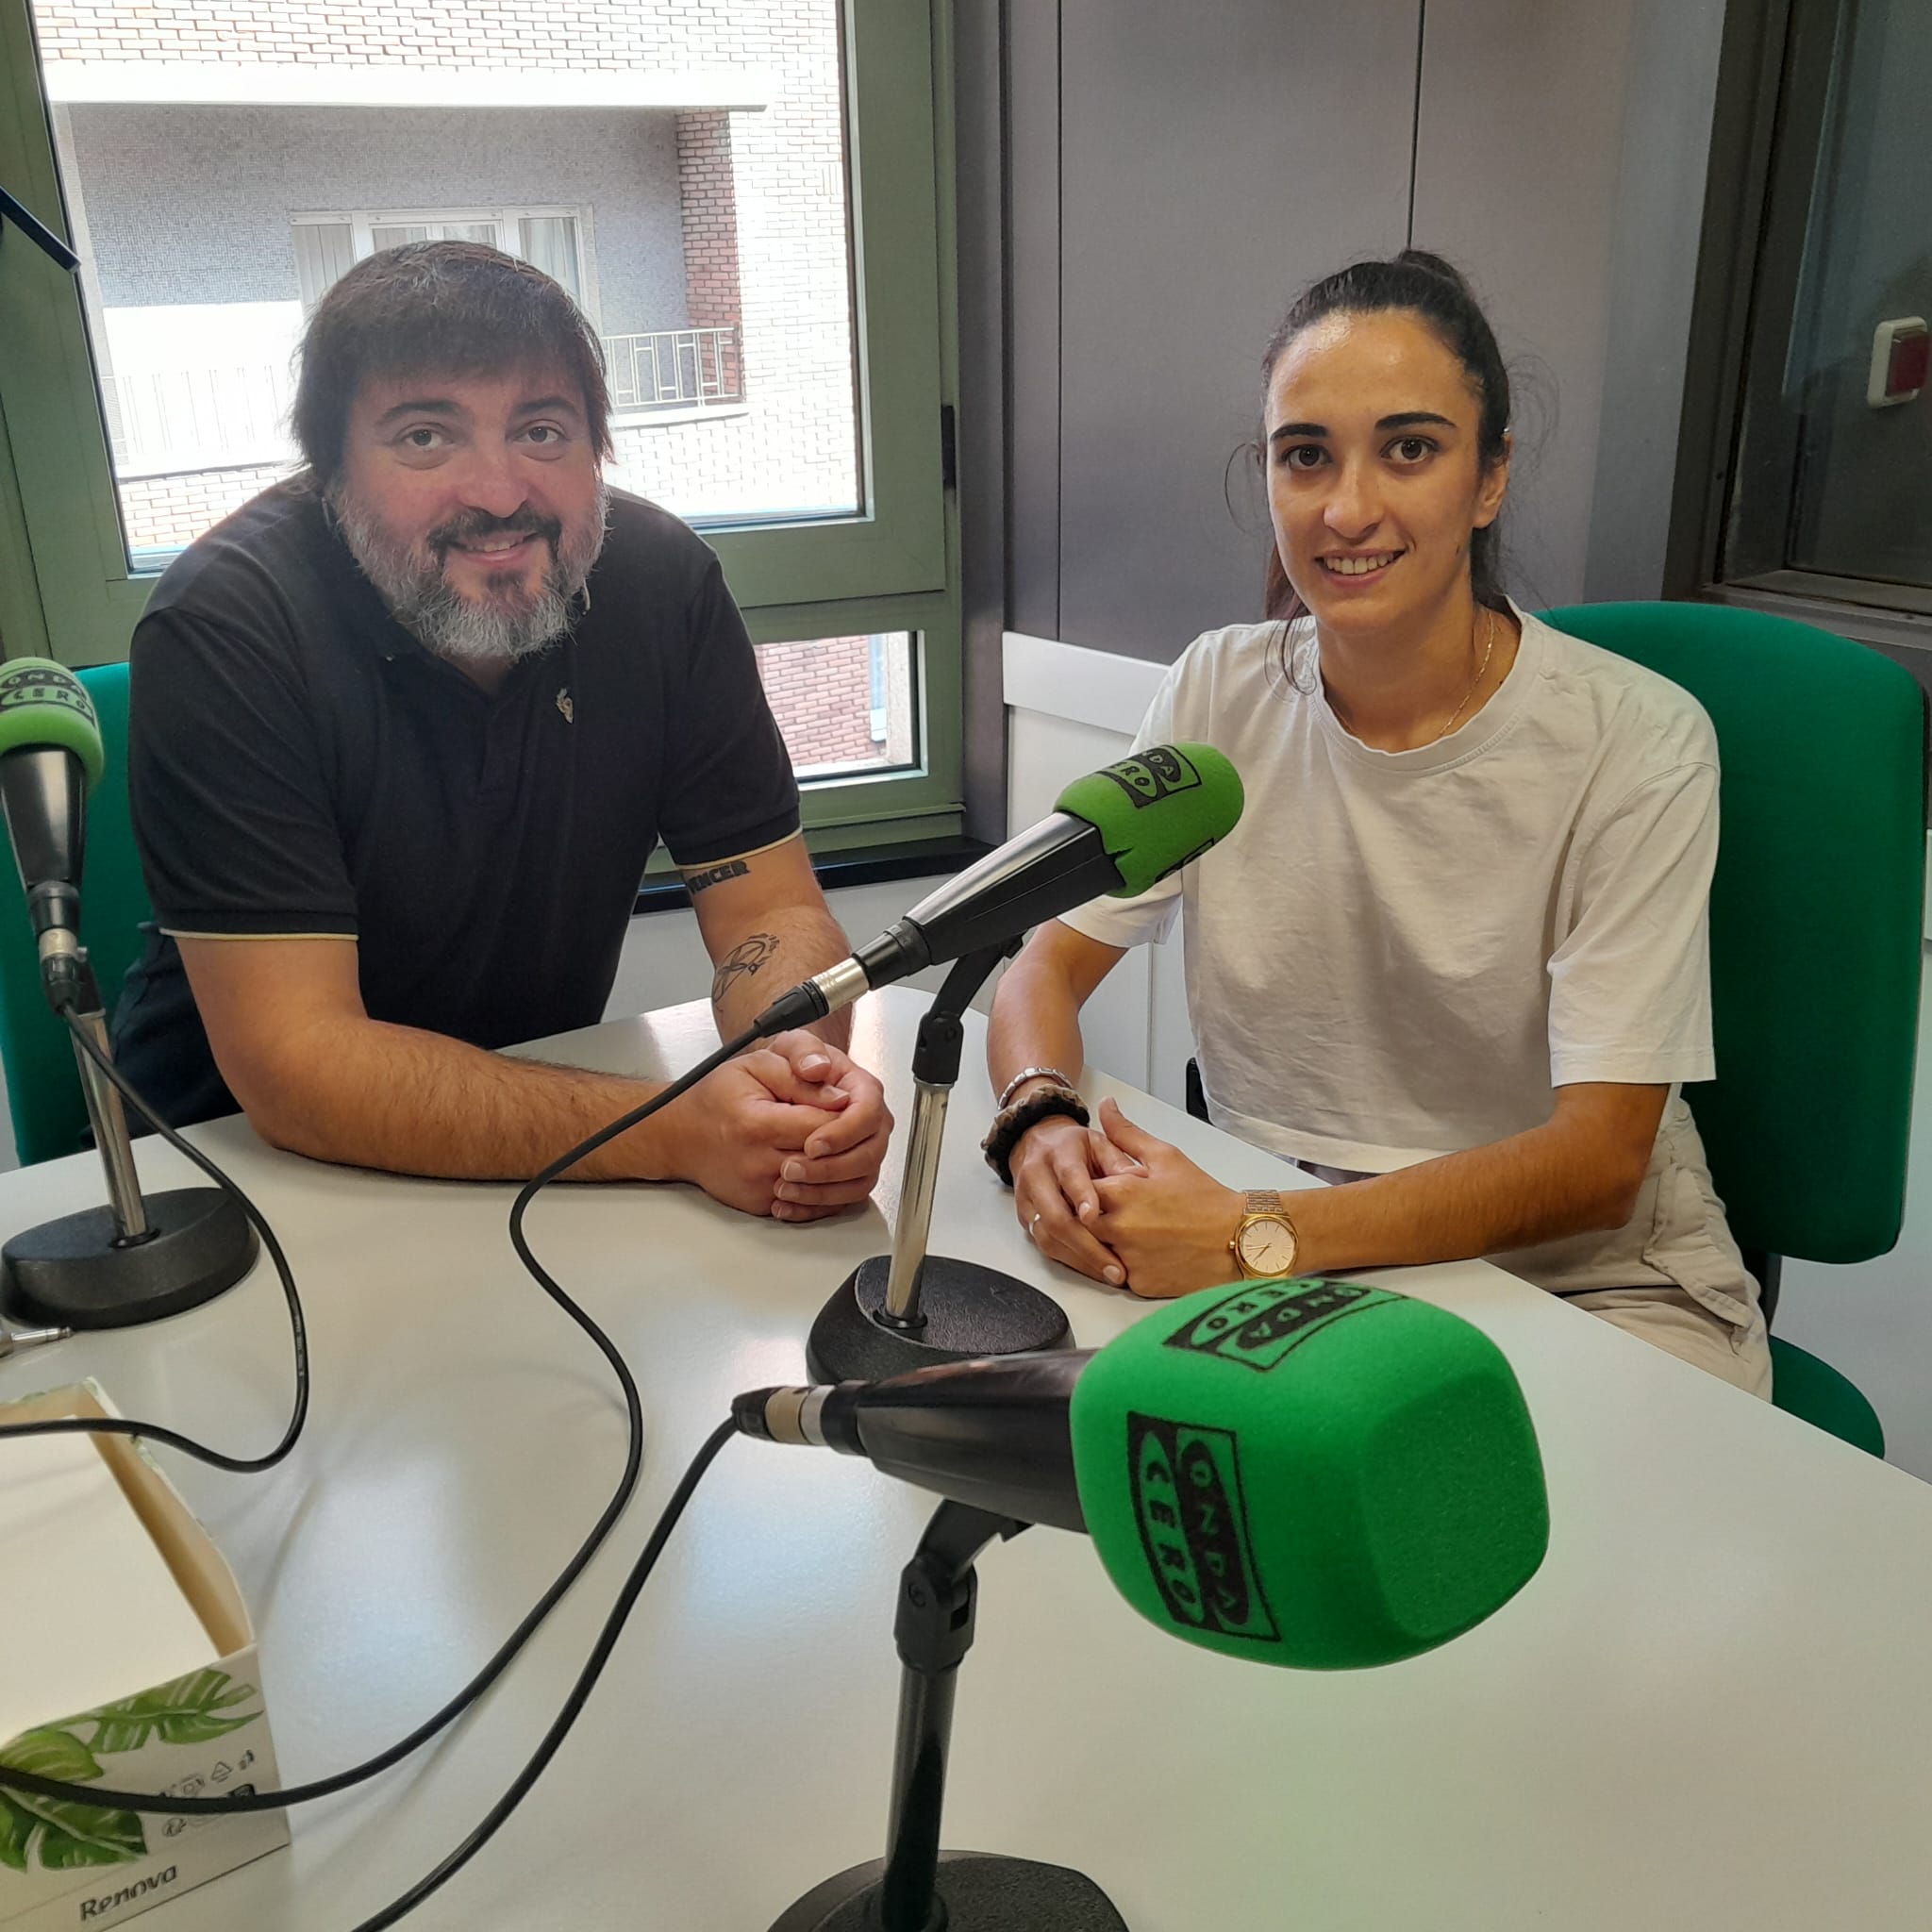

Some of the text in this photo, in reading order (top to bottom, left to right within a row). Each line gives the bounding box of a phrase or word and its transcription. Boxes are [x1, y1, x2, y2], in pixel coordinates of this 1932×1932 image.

[1145, 1460, 1196, 1604] CERO
[1191, 1459, 1241, 1612] ONDA
[79, 1865, 177, 1921] Renova
